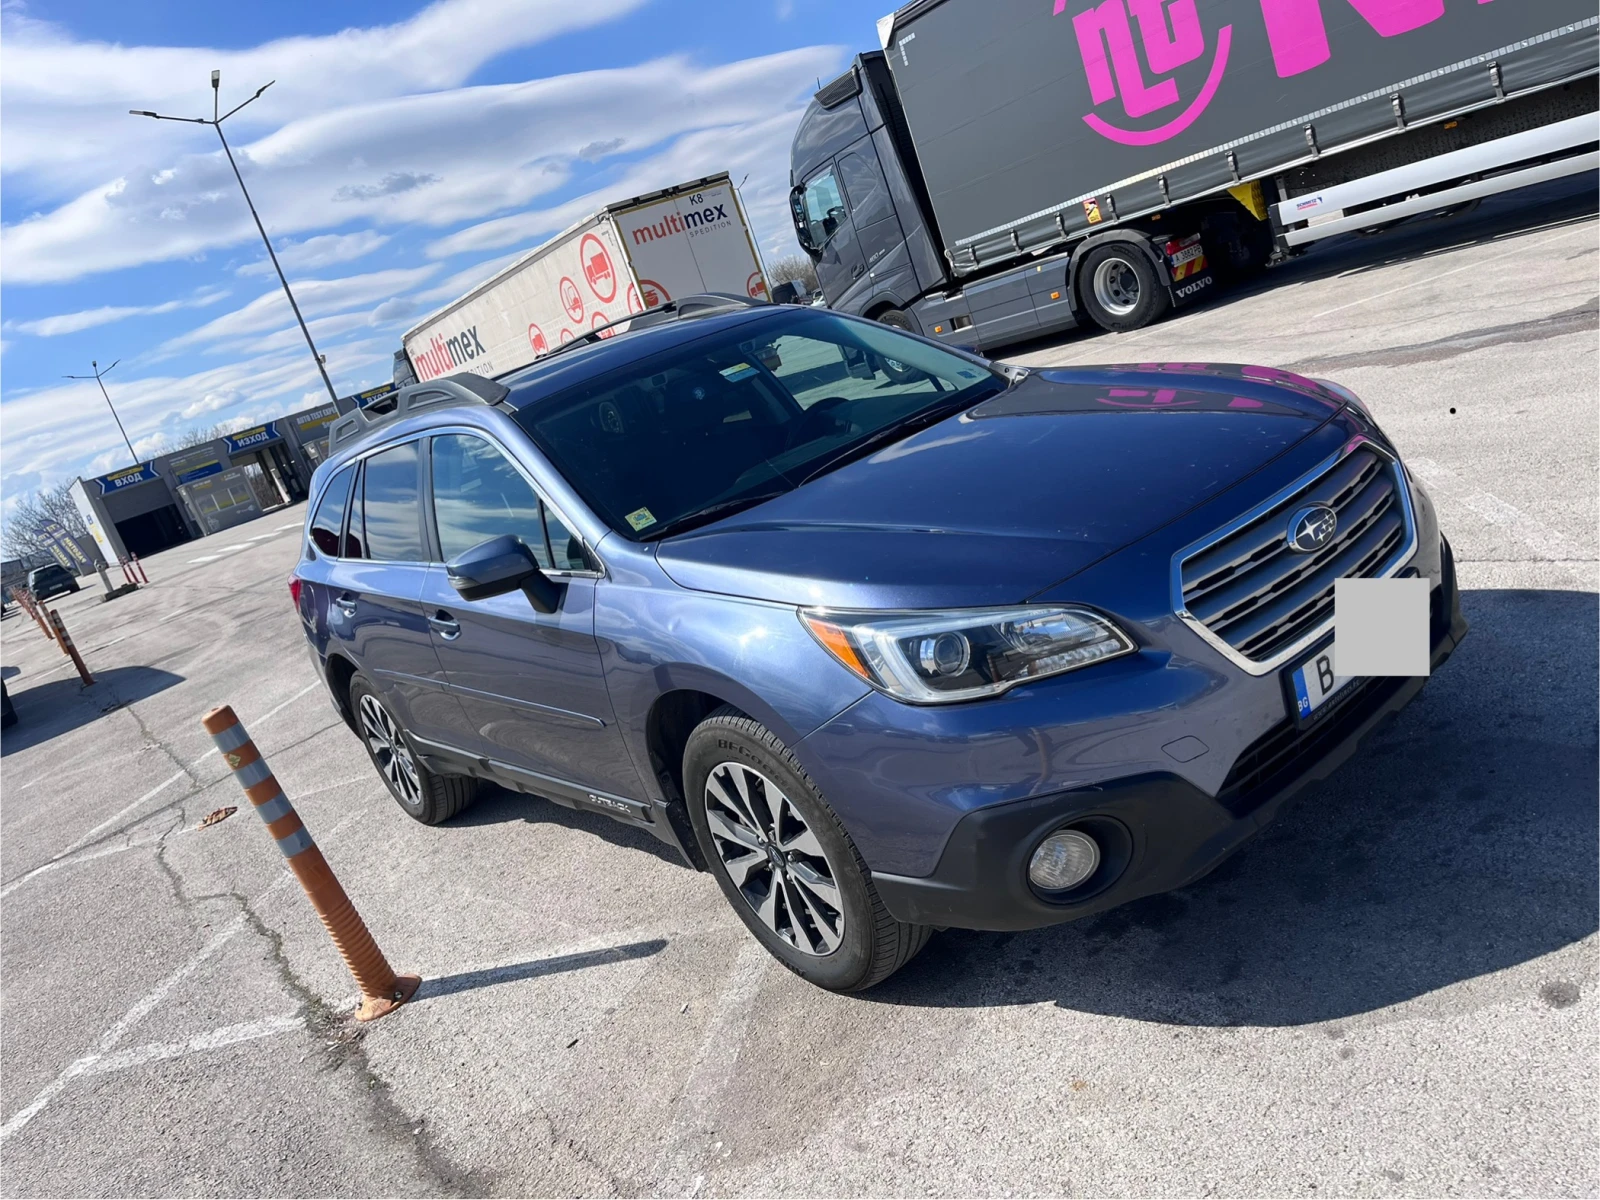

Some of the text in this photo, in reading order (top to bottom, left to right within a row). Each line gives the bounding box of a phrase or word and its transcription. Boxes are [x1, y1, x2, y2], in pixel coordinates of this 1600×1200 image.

[689, 193, 704, 206] K8
[632, 203, 728, 246] multimex
[689, 220, 732, 237] SPEDITION
[1175, 276, 1213, 298] VOLVO
[414, 325, 486, 382] multimex
[237, 431, 270, 448] ИЗХОД
[114, 472, 143, 487] ВХОД
[1297, 654, 1335, 712] BG B
